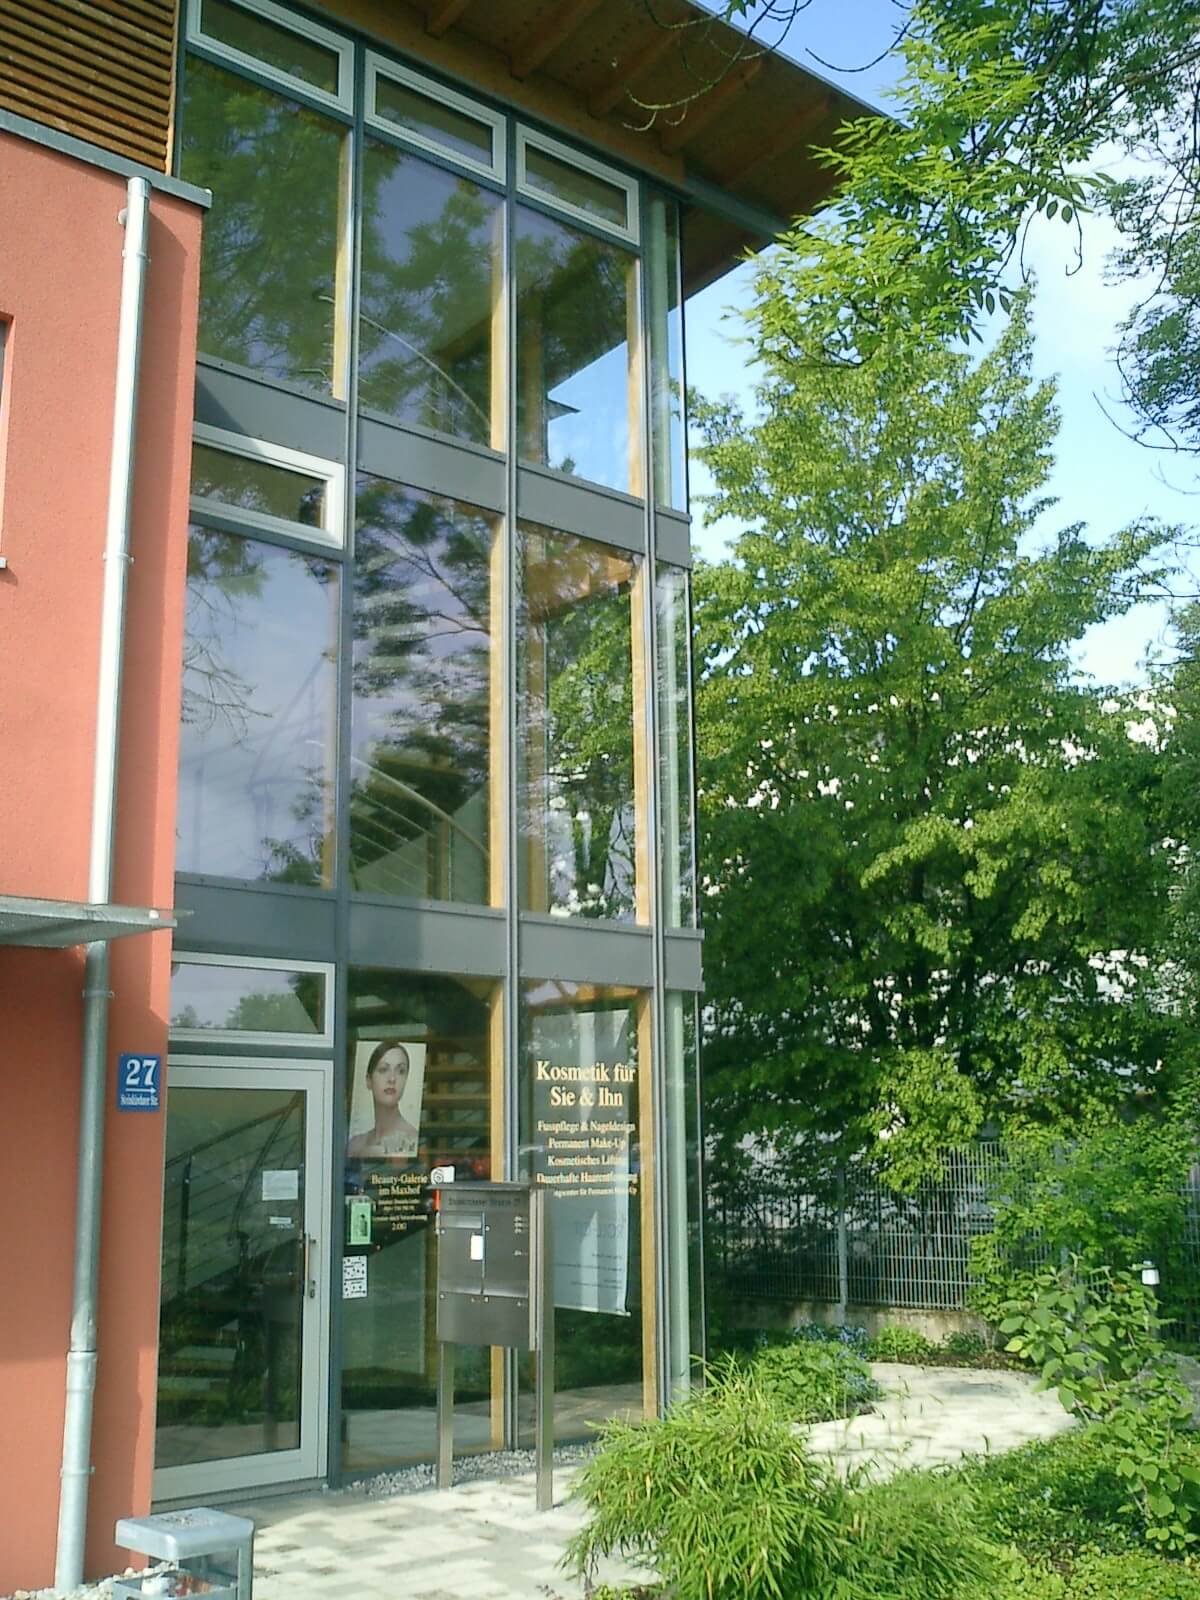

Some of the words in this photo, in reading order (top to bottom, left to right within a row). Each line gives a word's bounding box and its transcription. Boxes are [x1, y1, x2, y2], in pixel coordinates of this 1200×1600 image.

[126, 1059, 157, 1085] 27
[536, 1060, 610, 1082] Kosmetik
[614, 1062, 636, 1082] für
[550, 1086, 576, 1106] Sie
[580, 1087, 594, 1106] &
[598, 1087, 623, 1106] Ihn
[371, 1173, 428, 1185] Beauty-Galerie
